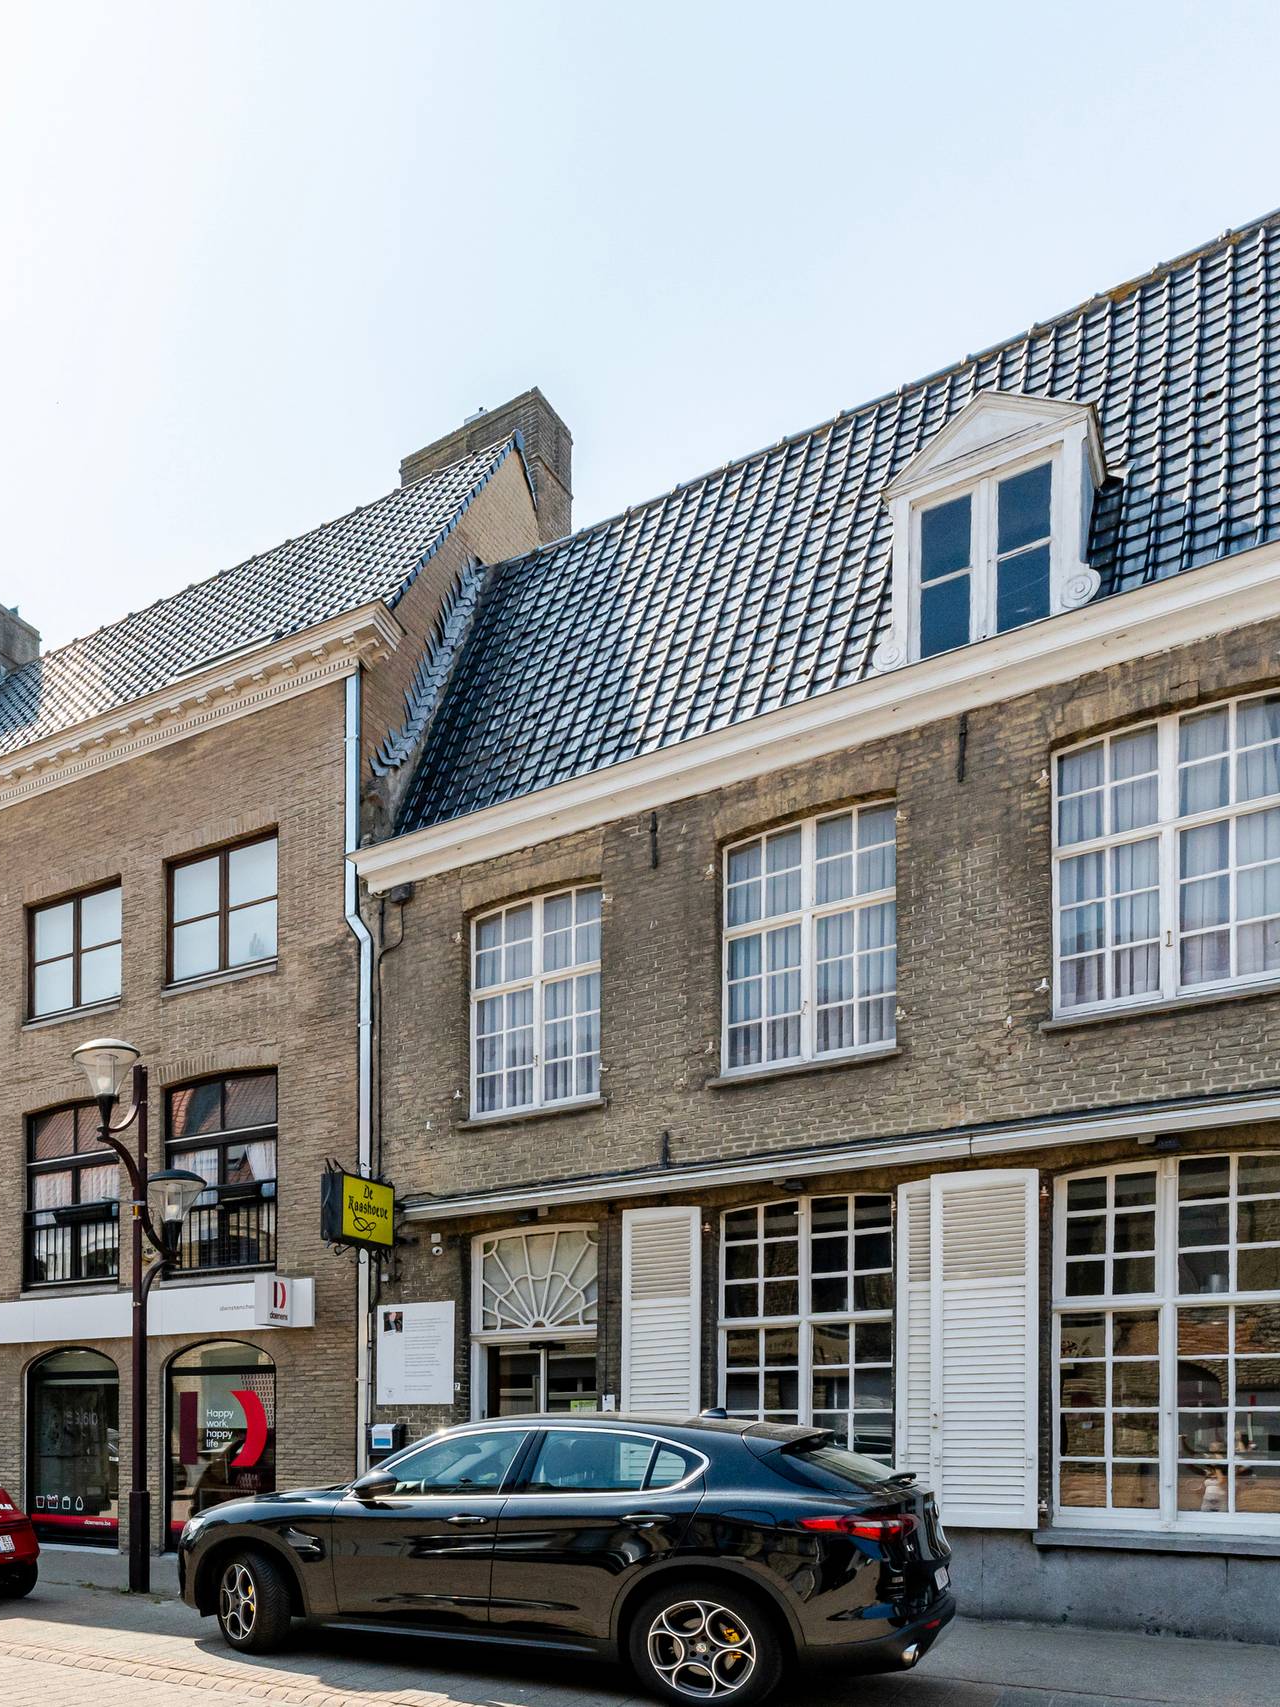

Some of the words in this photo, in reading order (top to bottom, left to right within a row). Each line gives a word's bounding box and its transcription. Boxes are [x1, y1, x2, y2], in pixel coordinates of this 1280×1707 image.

[363, 1185, 373, 1200] De
[348, 1195, 388, 1220] Kaashoeve
[206, 1409, 234, 1421] Happy
[206, 1419, 229, 1429] work,
[206, 1429, 233, 1441] happy
[206, 1438, 219, 1448] life
[84, 1519, 111, 1527] daenens.be
